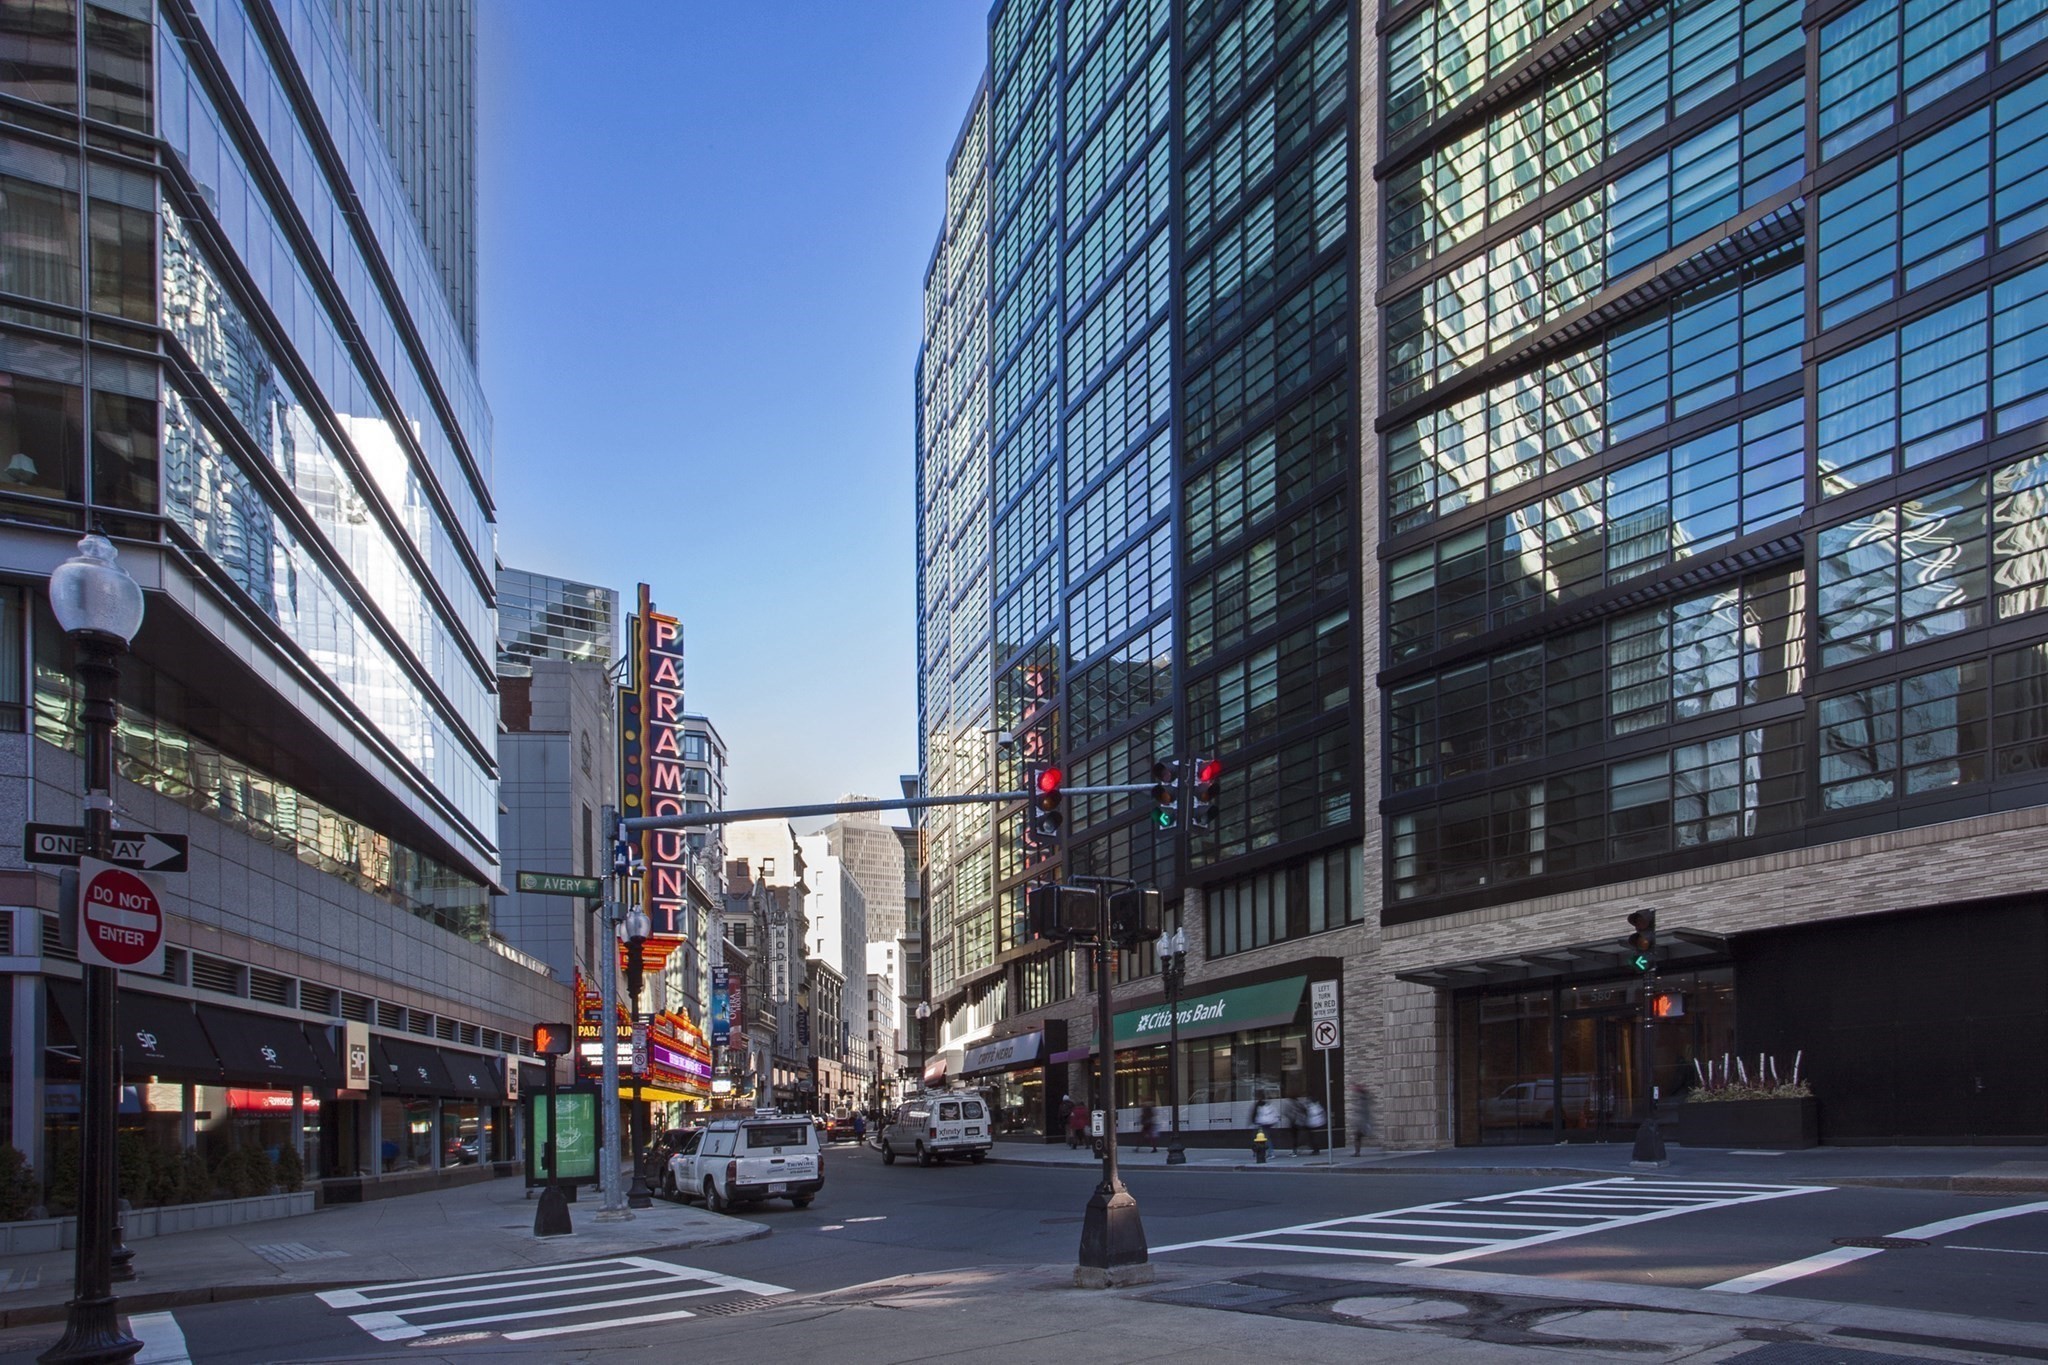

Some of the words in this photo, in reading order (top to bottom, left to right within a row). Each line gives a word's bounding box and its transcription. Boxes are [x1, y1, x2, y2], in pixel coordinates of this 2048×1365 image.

[653, 620, 681, 932] PARAMOUNT
[41, 835, 85, 853] ONE
[112, 841, 144, 858] AY
[544, 877, 582, 891] AVERY
[93, 885, 113, 903] DO
[119, 892, 152, 911] NOT
[99, 925, 145, 947] ENTER
[775, 929, 785, 996] MODERN
[1317, 984, 1330, 992] LEFT
[1591, 990, 1611, 1001] 580
[729, 993, 737, 1020] OPERA
[1193, 999, 1226, 1022] Bank
[1313, 1001, 1323, 1009] ON
[1324, 999, 1336, 1008] RED
[994, 1047, 1014, 1062] NERO
[939, 1127, 961, 1137] xfinity
